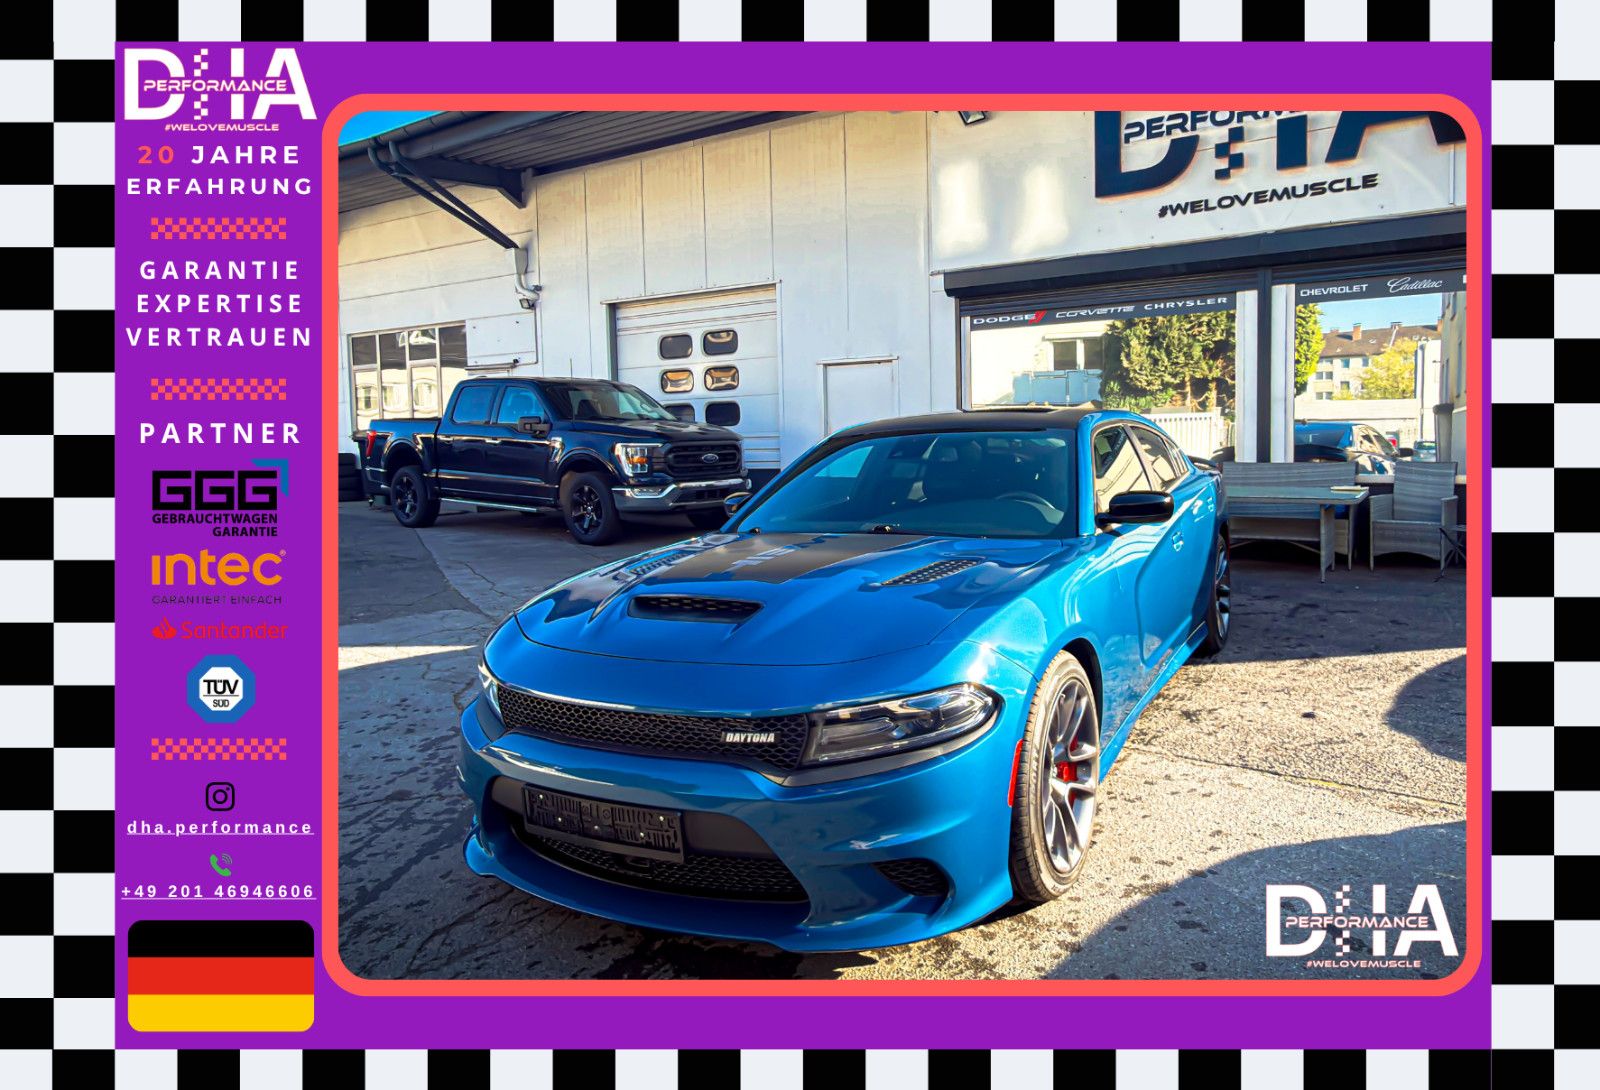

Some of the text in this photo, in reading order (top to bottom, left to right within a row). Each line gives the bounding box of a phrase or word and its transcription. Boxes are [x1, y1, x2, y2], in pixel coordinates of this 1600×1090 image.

[1158, 173, 1379, 218] #WELOVEMUSCLE
[1300, 283, 1369, 297] CHEVROLET
[1387, 276, 1443, 293] Cadillac
[1144, 296, 1227, 311] CHRYSLER
[973, 312, 1036, 325] DODGE
[1055, 304, 1136, 319] CORVETTE
[726, 732, 775, 743] DAYTONA
